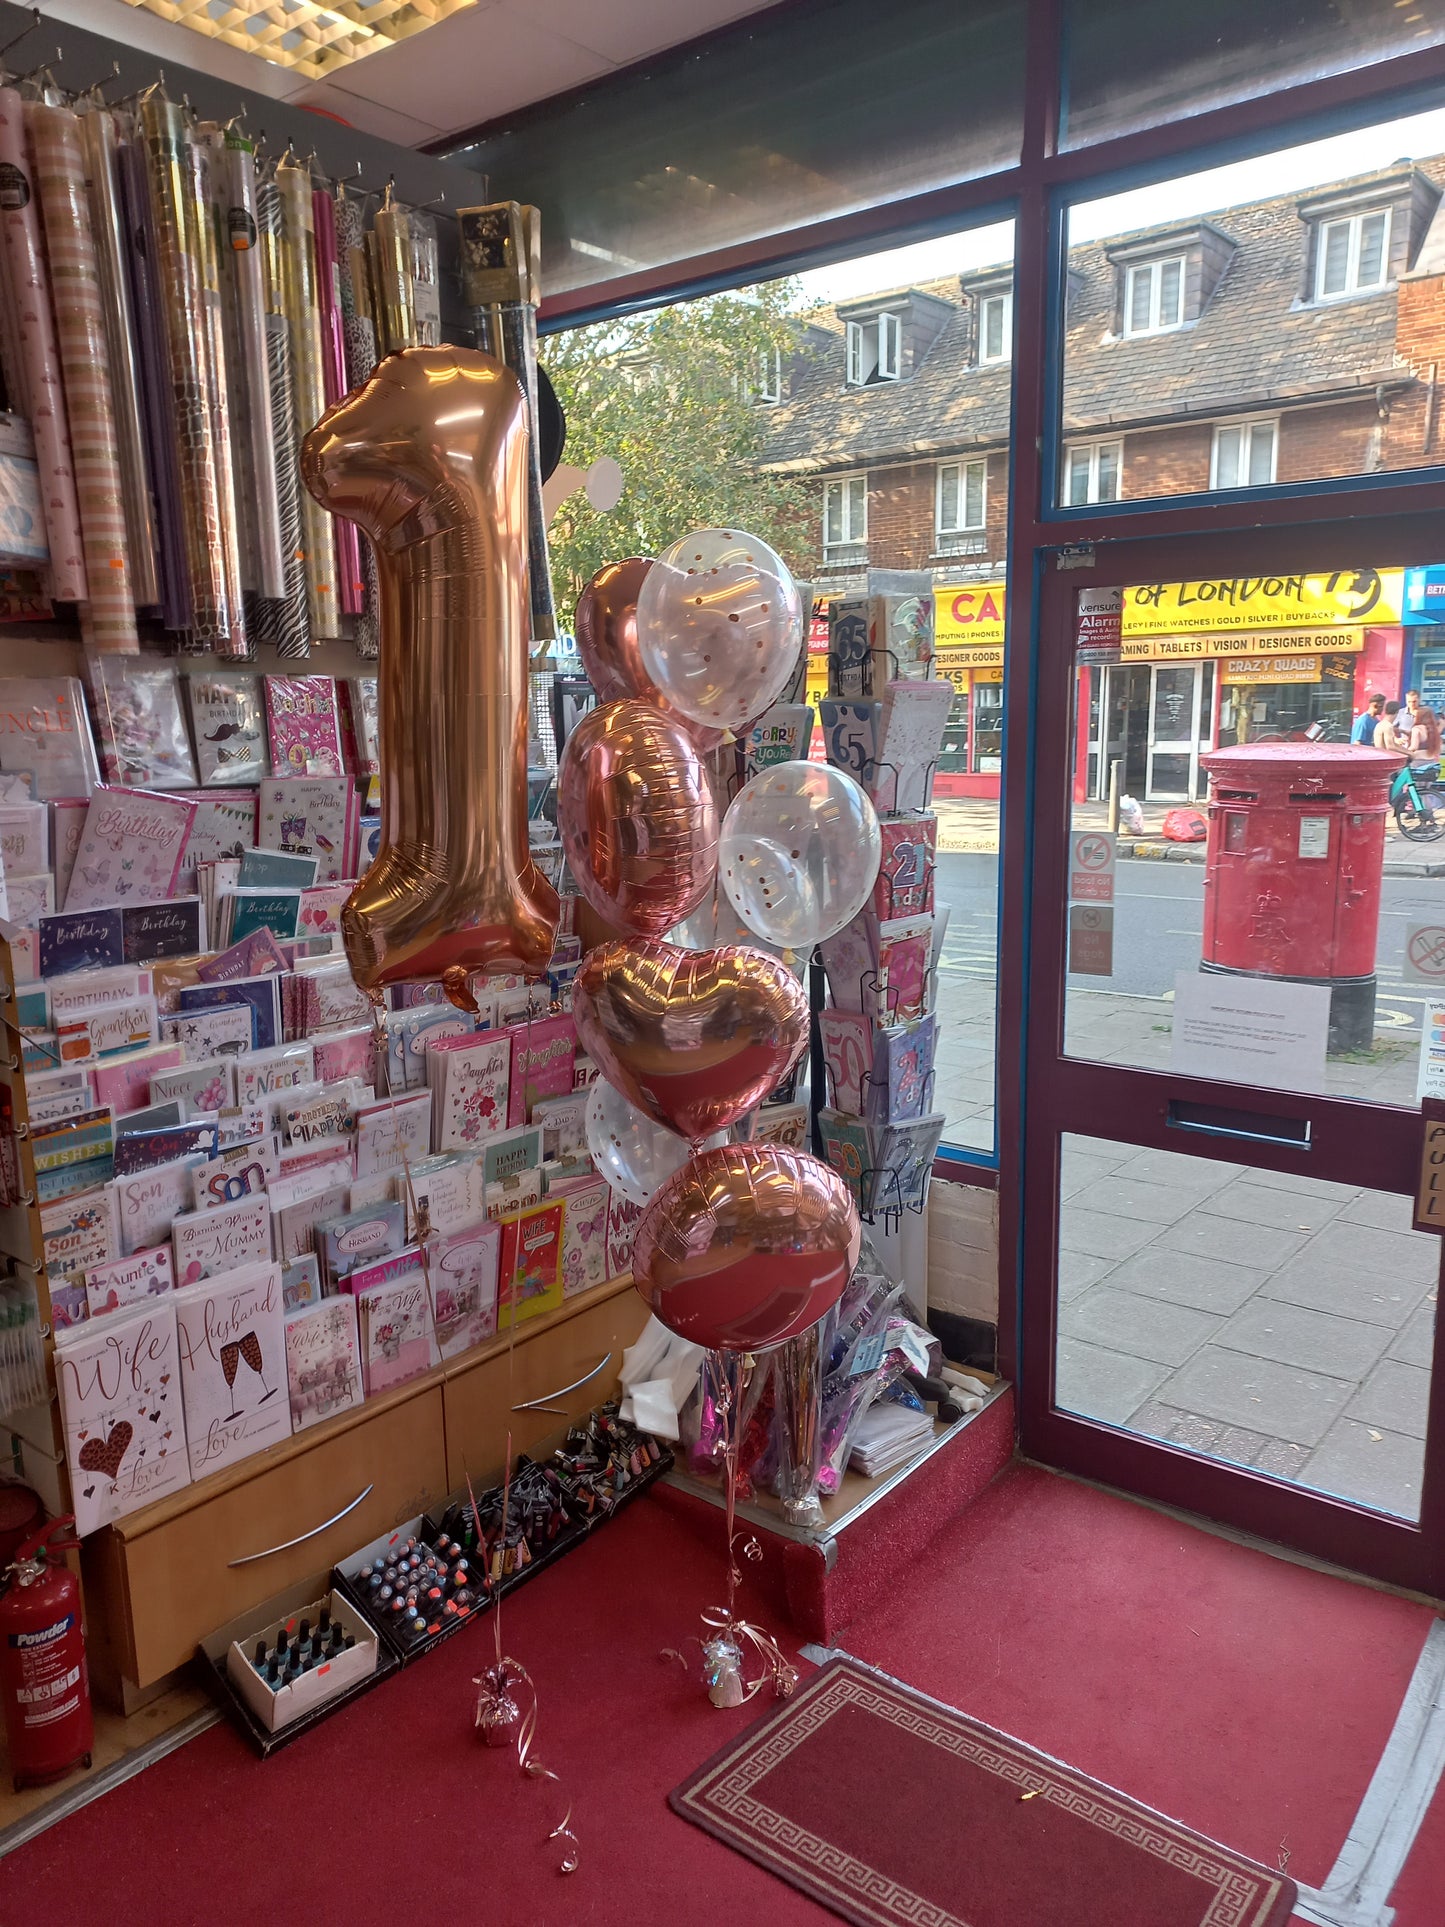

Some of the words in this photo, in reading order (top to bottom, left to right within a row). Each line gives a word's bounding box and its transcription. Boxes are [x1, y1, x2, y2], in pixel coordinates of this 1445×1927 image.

[1177, 573, 1308, 606] LONDON
[1080, 603, 1121, 613] verisure
[1170, 618, 1211, 627] WATCHES
[1216, 616, 1241, 625] GOLD
[1247, 614, 1279, 622] SILVER
[1285, 611, 1336, 621] BUYBACKS
[1080, 616, 1121, 628] Alarm
[836, 623, 868, 662] 65
[970, 631, 1000, 639] PHONES
[1160, 642, 1202, 653] TABLETS
[1213, 640, 1248, 650] VISION
[1258, 635, 1311, 649] DESIGNER
[1314, 634, 1353, 646] GOODS
[973, 652, 1000, 662] GOODS
[1227, 661, 1271, 673] CRAZY
[1274, 658, 1316, 671] QUADS
[752, 726, 796, 743] SORRY
[832, 725, 866, 771] 65
[301, 787, 322, 795] HAPPY
[96, 808, 178, 849] Birthday
[893, 842, 926, 888] 21
[247, 902, 289, 916] Birthday
[57, 922, 110, 945] Birthday
[141, 914, 187, 931] Birthday
[218, 959, 246, 981] BIRTHDAY
[64, 988, 137, 1009] BIRTHDAY
[91, 1008, 150, 1048] Grandson
[518, 1037, 573, 1073] Daughter
[826, 1033, 867, 1092] 50
[453, 1056, 505, 1086] Daughter
[153, 1078, 194, 1102] Niece
[35, 1143, 107, 1171] WISHES
[149, 1136, 179, 1157] Son
[496, 1148, 528, 1166] HAPPY
[496, 1159, 528, 1175] BIRTHDAY
[827, 1141, 862, 1176] 50
[61, 1173, 84, 1185] FOR
[127, 1182, 163, 1215] Son
[182, 1225, 223, 1242] BIRTHDAY
[224, 1213, 257, 1228] WISHES
[523, 1217, 547, 1240] WIFE
[48, 1234, 81, 1255] Son
[206, 1229, 265, 1259] MUMMY
[348, 1231, 381, 1249] HUSBAND
[105, 1263, 156, 1291] Auntie
[383, 1256, 421, 1282] Wife
[392, 1289, 422, 1312] Wife
[178, 1275, 278, 1370] Husband
[293, 1330, 321, 1349] Wife
[62, 1320, 171, 1401] Wife
[194, 1417, 248, 1469] Love
[122, 1457, 169, 1501] Love
[17, 1618, 70, 1647] Powder
